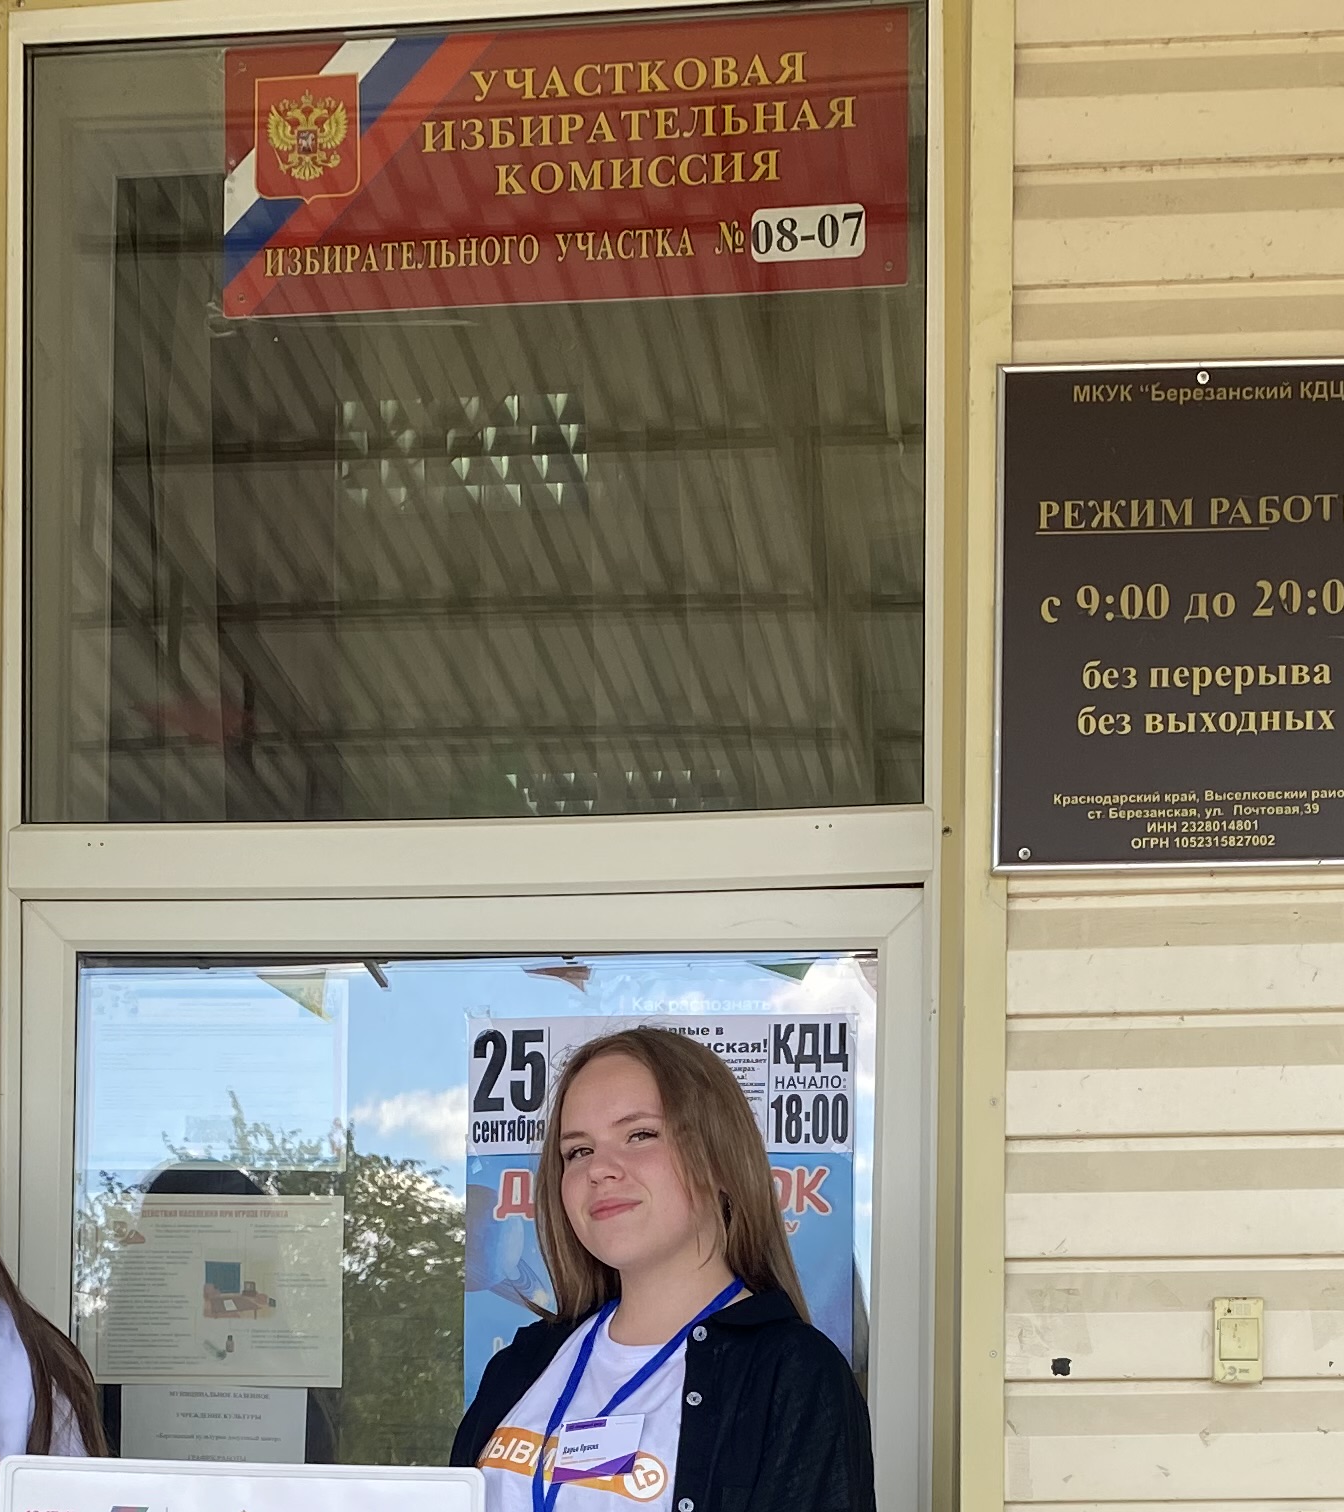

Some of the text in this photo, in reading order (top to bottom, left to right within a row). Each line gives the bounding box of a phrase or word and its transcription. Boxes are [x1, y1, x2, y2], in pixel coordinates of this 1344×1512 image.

[471, 51, 808, 102] УЧАСТКОВАЯ
[421, 96, 857, 153] ИЗБИРАТЕЛЬНАЯ
[495, 149, 782, 197] КОМИССИЯ
[264, 233, 541, 278] ИЗБИРАТЕЛЬНОГО
[555, 221, 696, 263] УЧАСТКА
[753, 208, 867, 256] 08-07
[1073, 385, 1133, 403] МКУК
[1038, 497, 1194, 530] РЕЖИМ
[1040, 595, 1061, 623] с
[1076, 583, 1171, 621] 9:00
[1184, 592, 1236, 623] до
[1082, 660, 1333, 695] без перерыва
[1077, 706, 1336, 736] без выходных
[1053, 791, 1161, 807] Краснодарский
[1108, 807, 1201, 821] Березанская,
[1131, 835, 1276, 849] ОГРН 1052315827002
[1147, 820, 1259, 834] ИНН 2328014801
[773, 1023, 849, 1073] КДЦ
[472, 1028, 546, 1114] 25
[775, 1075, 847, 1090] НАЧАЛО:
[472, 1115, 546, 1145] сентября
[771, 1093, 849, 1145] 18:00
